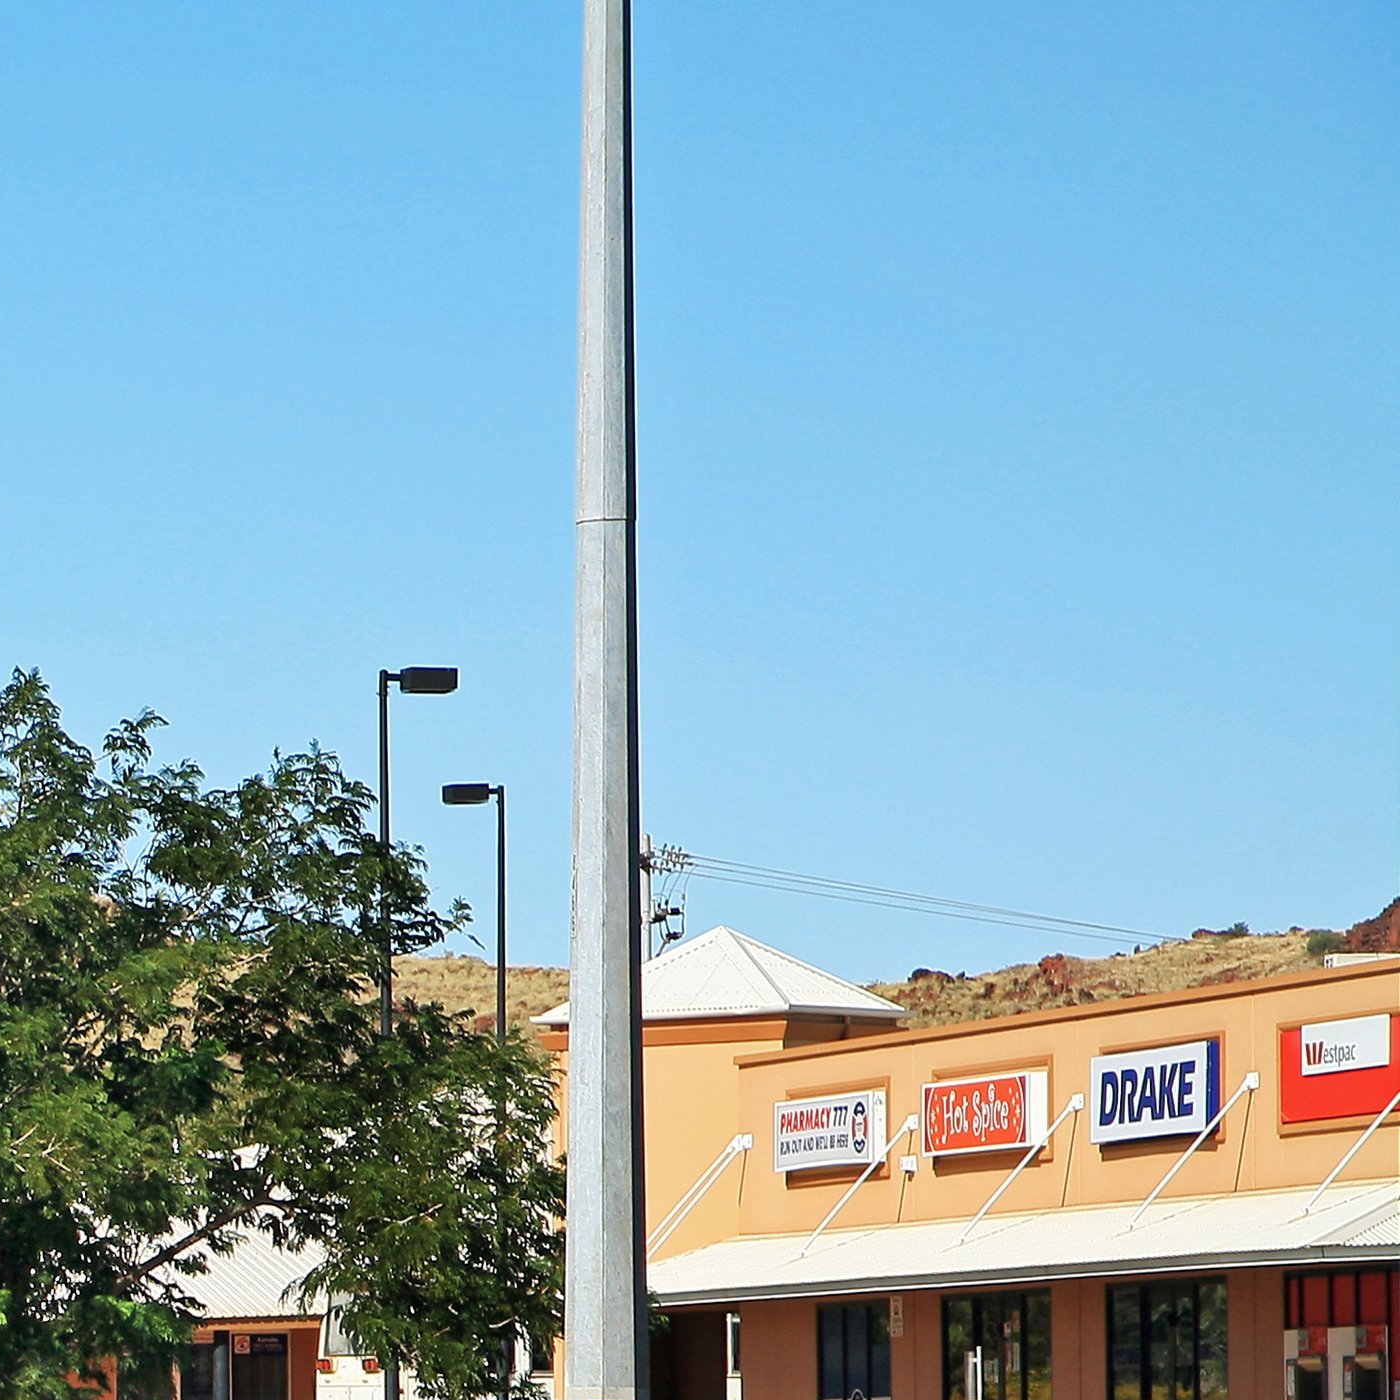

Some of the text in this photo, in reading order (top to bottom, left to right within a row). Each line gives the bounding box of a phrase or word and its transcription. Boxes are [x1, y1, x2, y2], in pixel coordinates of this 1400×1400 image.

[1305, 1041, 1356, 1067] Westpac
[941, 1083, 1009, 1144] Hot Spice
[1099, 1060, 1196, 1127] DRAKE
[780, 1106, 848, 1134] PHARMACY 777
